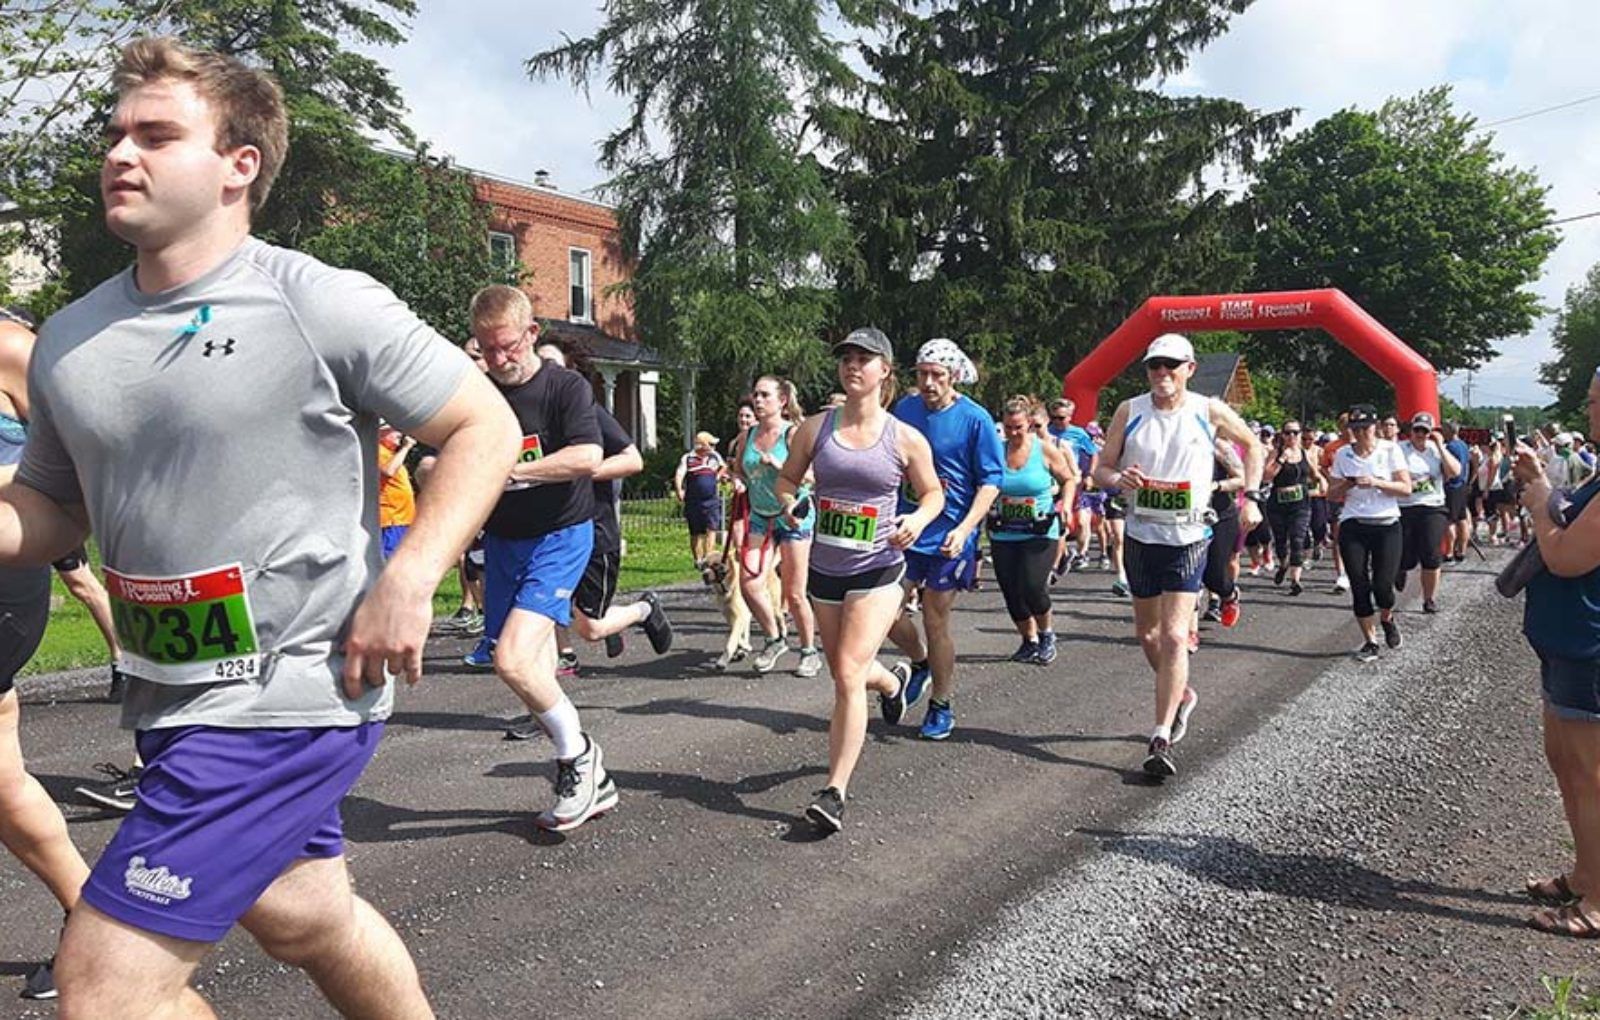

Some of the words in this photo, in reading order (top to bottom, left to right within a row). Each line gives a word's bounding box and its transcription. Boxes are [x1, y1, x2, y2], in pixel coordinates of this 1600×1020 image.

[1220, 310, 1254, 320] FINISH
[1221, 301, 1254, 310] START
[1138, 488, 1187, 510] 4035
[819, 512, 871, 540] 4051
[215, 659, 255, 678] 4234
